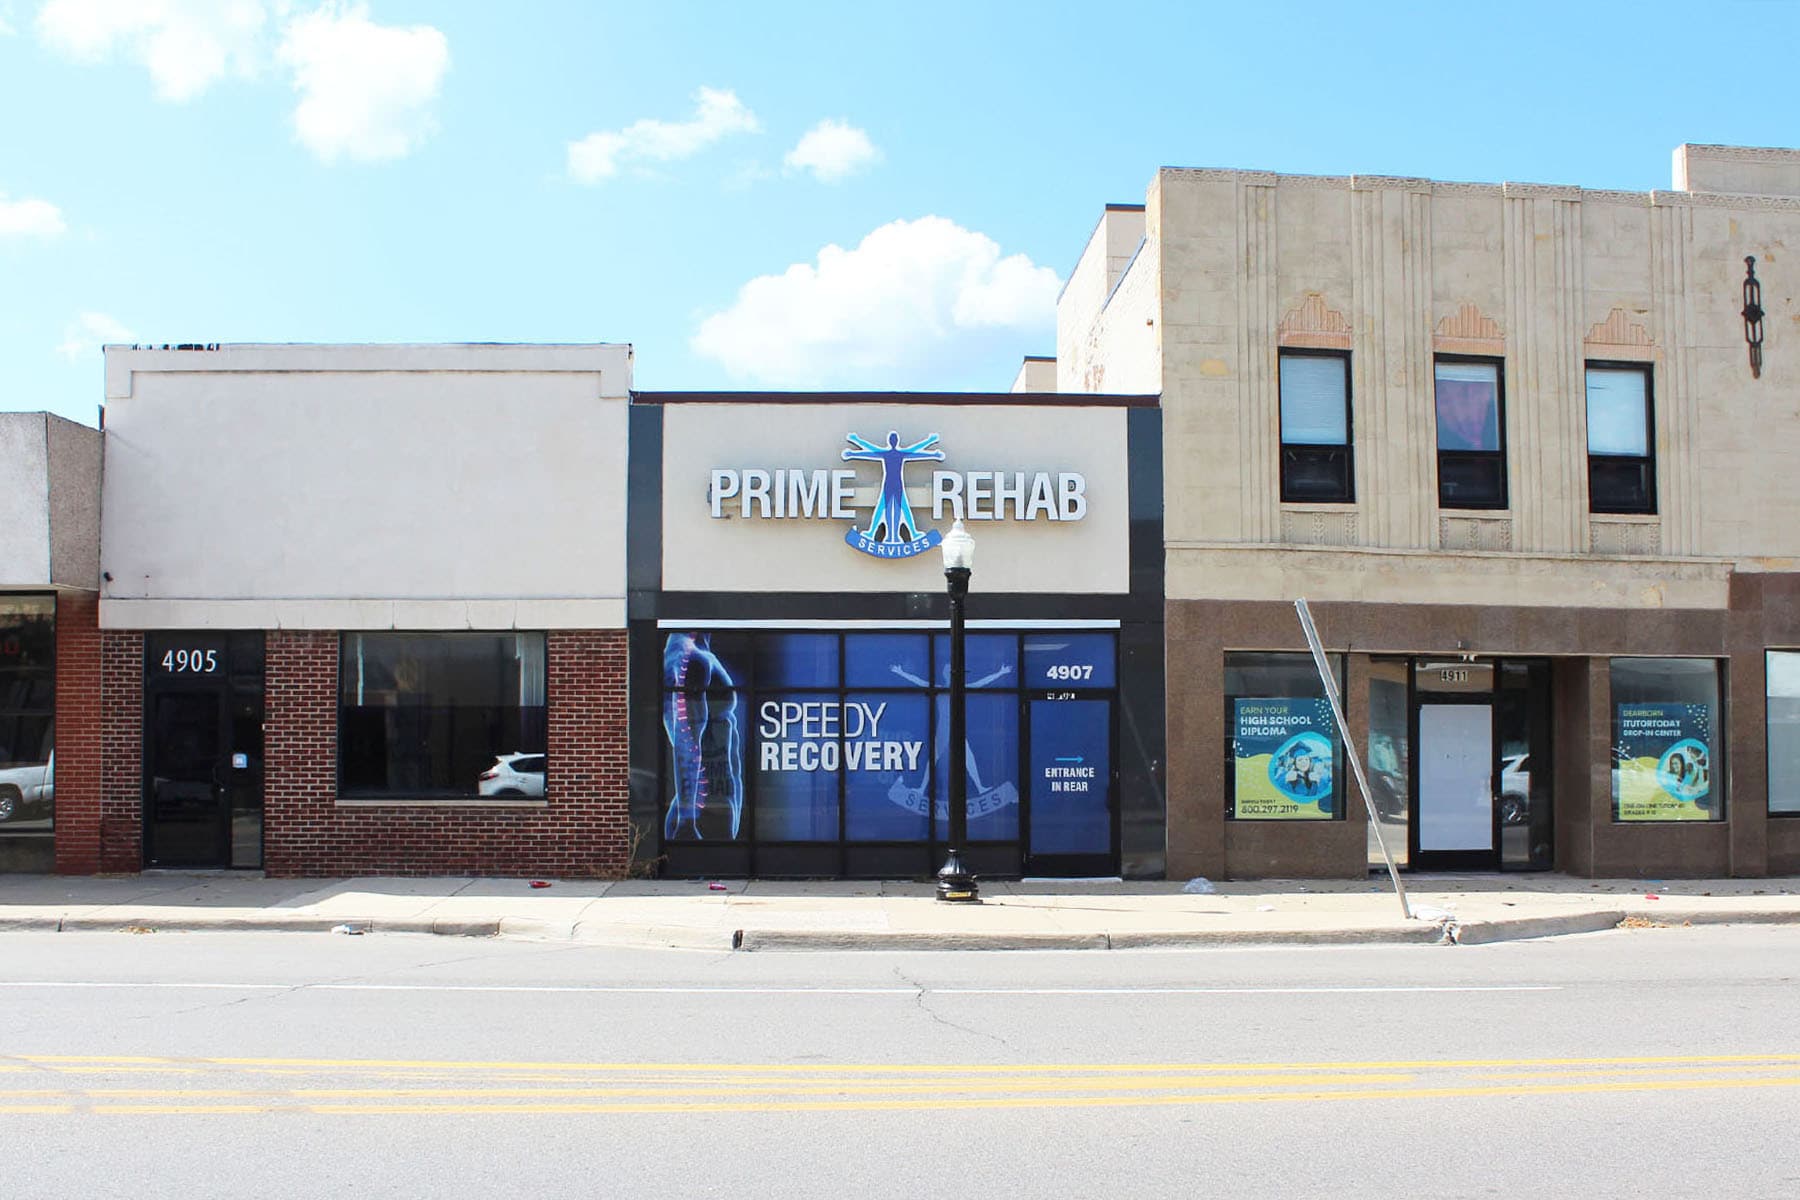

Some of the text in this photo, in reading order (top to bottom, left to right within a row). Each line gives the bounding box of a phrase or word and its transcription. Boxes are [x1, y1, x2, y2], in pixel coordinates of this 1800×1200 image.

[710, 469, 1087, 521] PRIME REHAB
[858, 537, 930, 556] SERVICES
[161, 649, 217, 673] 4905
[1046, 665, 1094, 680] 4907
[1441, 670, 1466, 681] 4911
[1240, 706, 1288, 715] EARN YOUR
[759, 701, 887, 739] SPEEDY
[1240, 716, 1312, 725] HIGH SCHOOL
[1240, 727, 1287, 736] DIPLOMA
[1655, 729, 1682, 737] CENTER
[760, 741, 922, 772] RECOVERY
[1045, 767, 1095, 778] ENTRANCE
[1051, 781, 1088, 792] IN REAR
